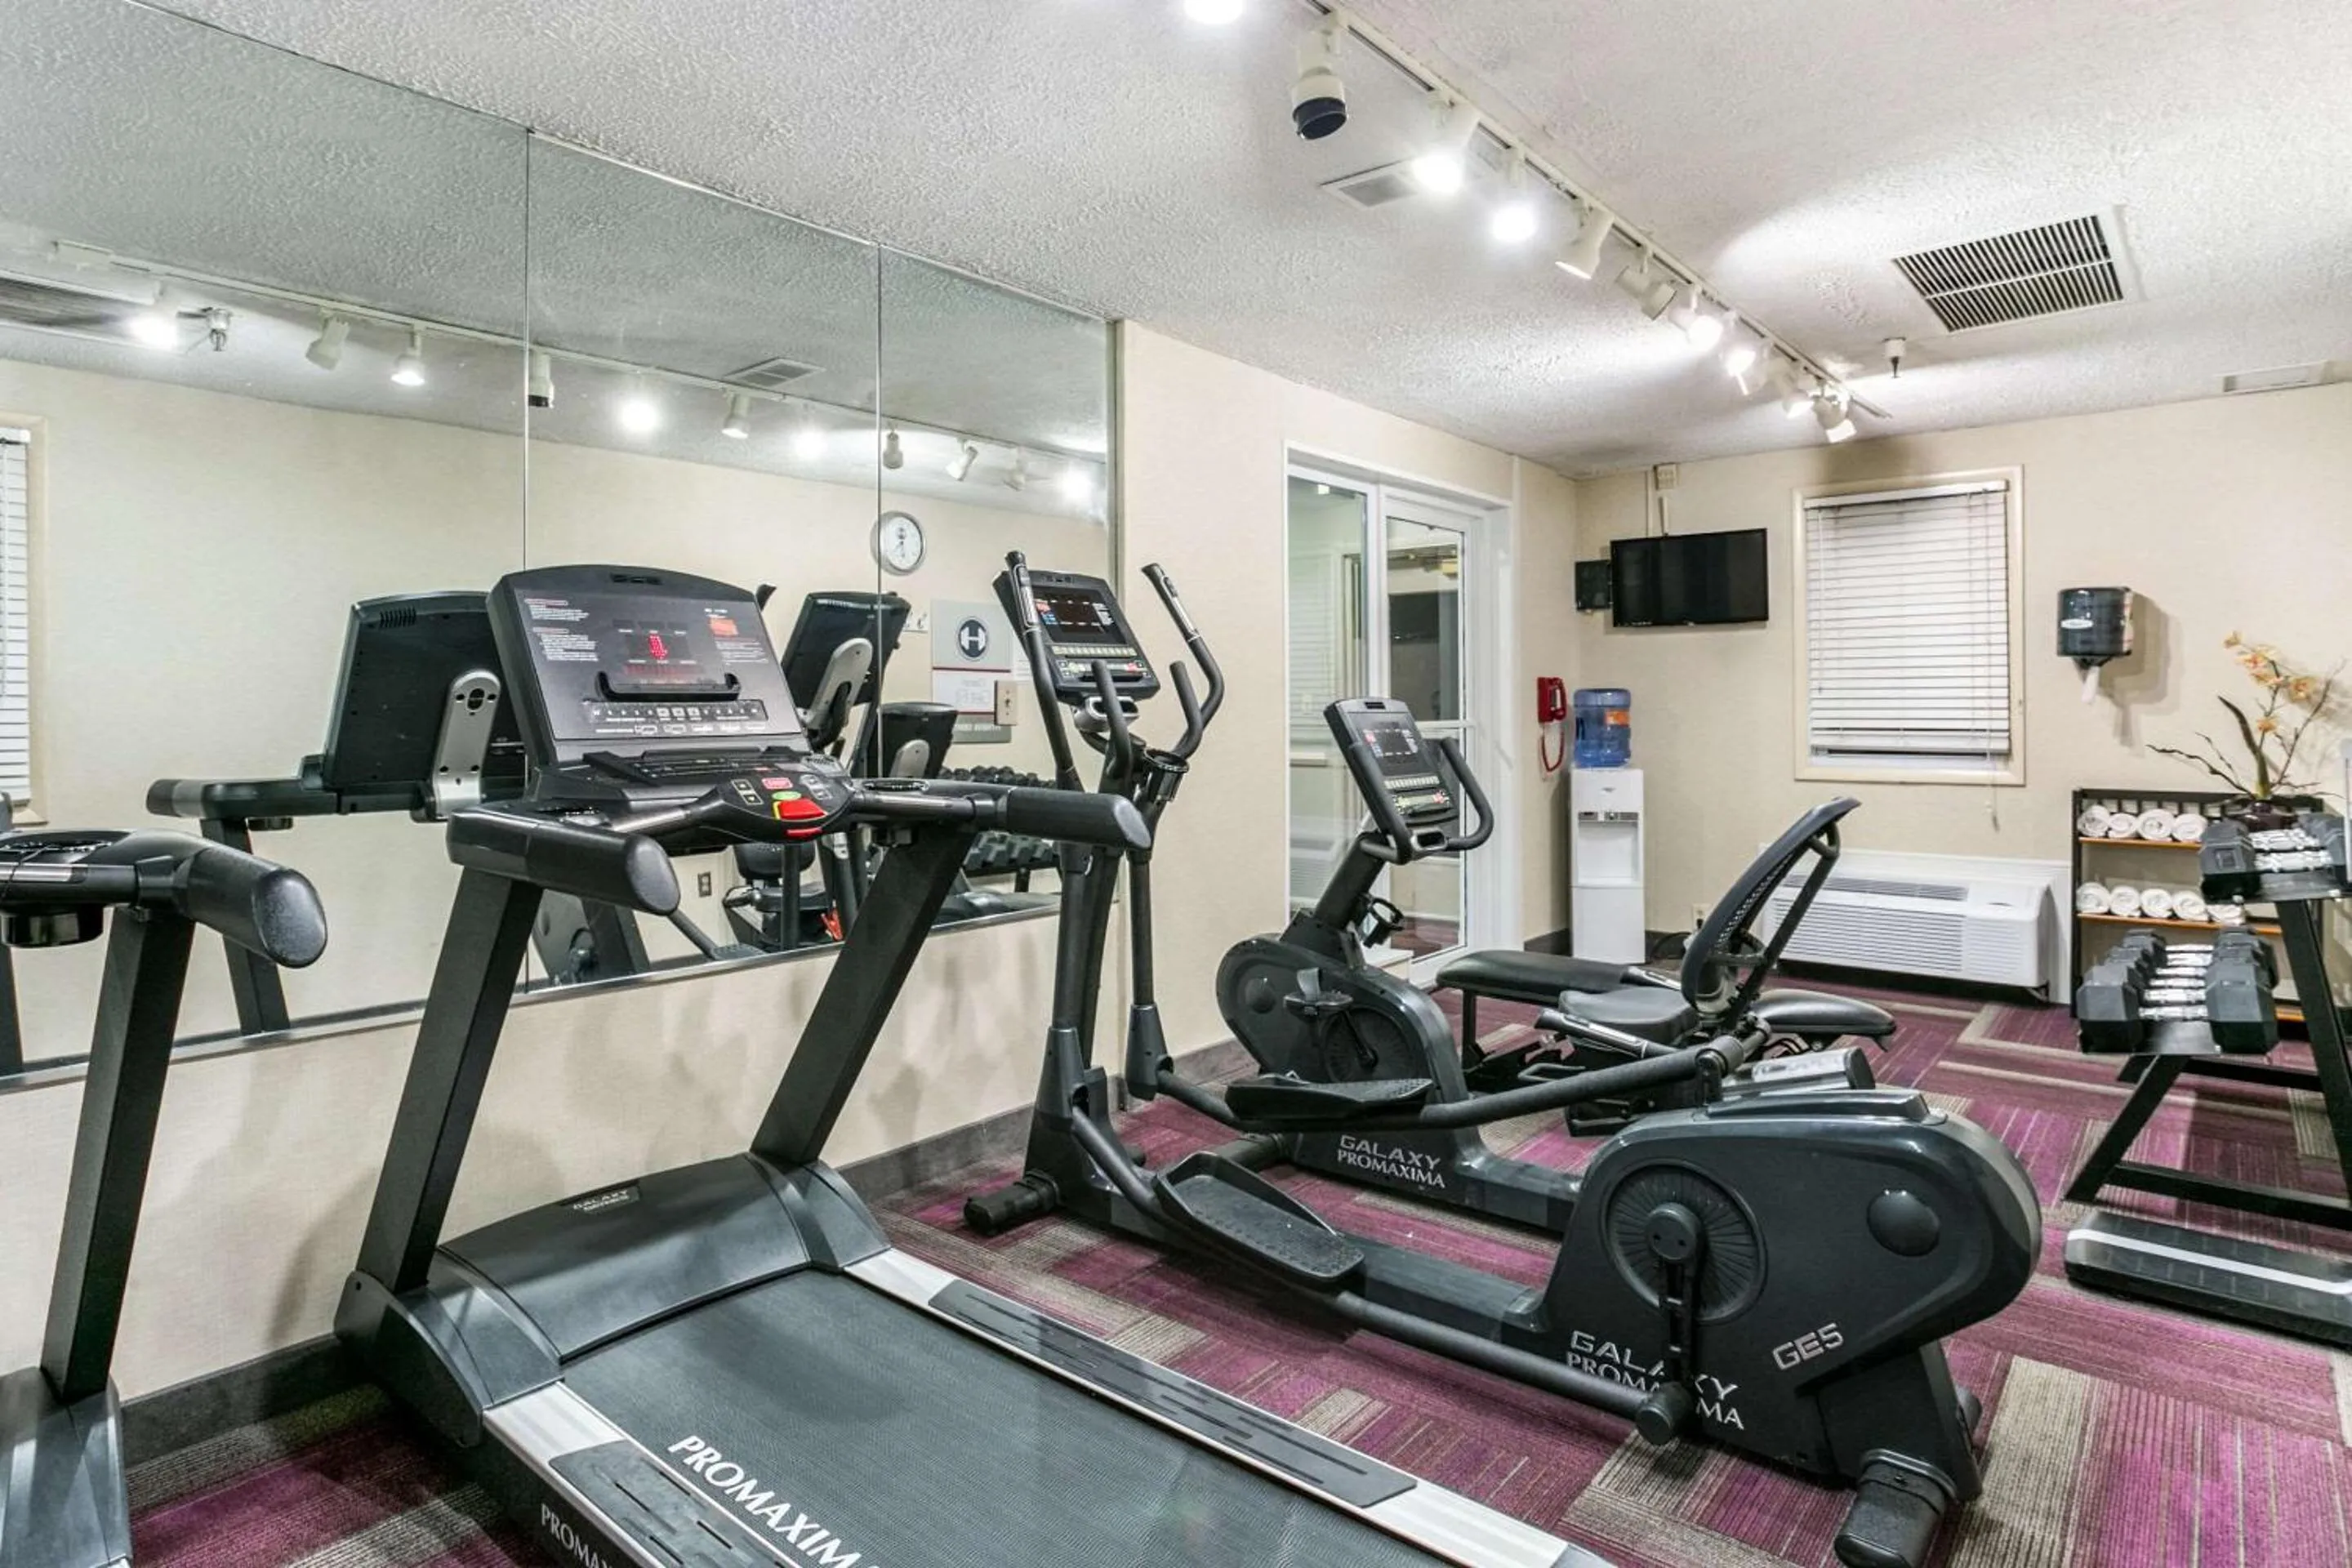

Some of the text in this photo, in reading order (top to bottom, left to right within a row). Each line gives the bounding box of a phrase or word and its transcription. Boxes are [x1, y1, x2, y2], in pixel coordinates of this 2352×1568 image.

[1337, 1148, 1446, 1188] PROMAXIMA
[1339, 1134, 1441, 1170] GALAXY
[1772, 1322, 1844, 1370] GE5
[667, 1435, 881, 1568] PROMAXIM
